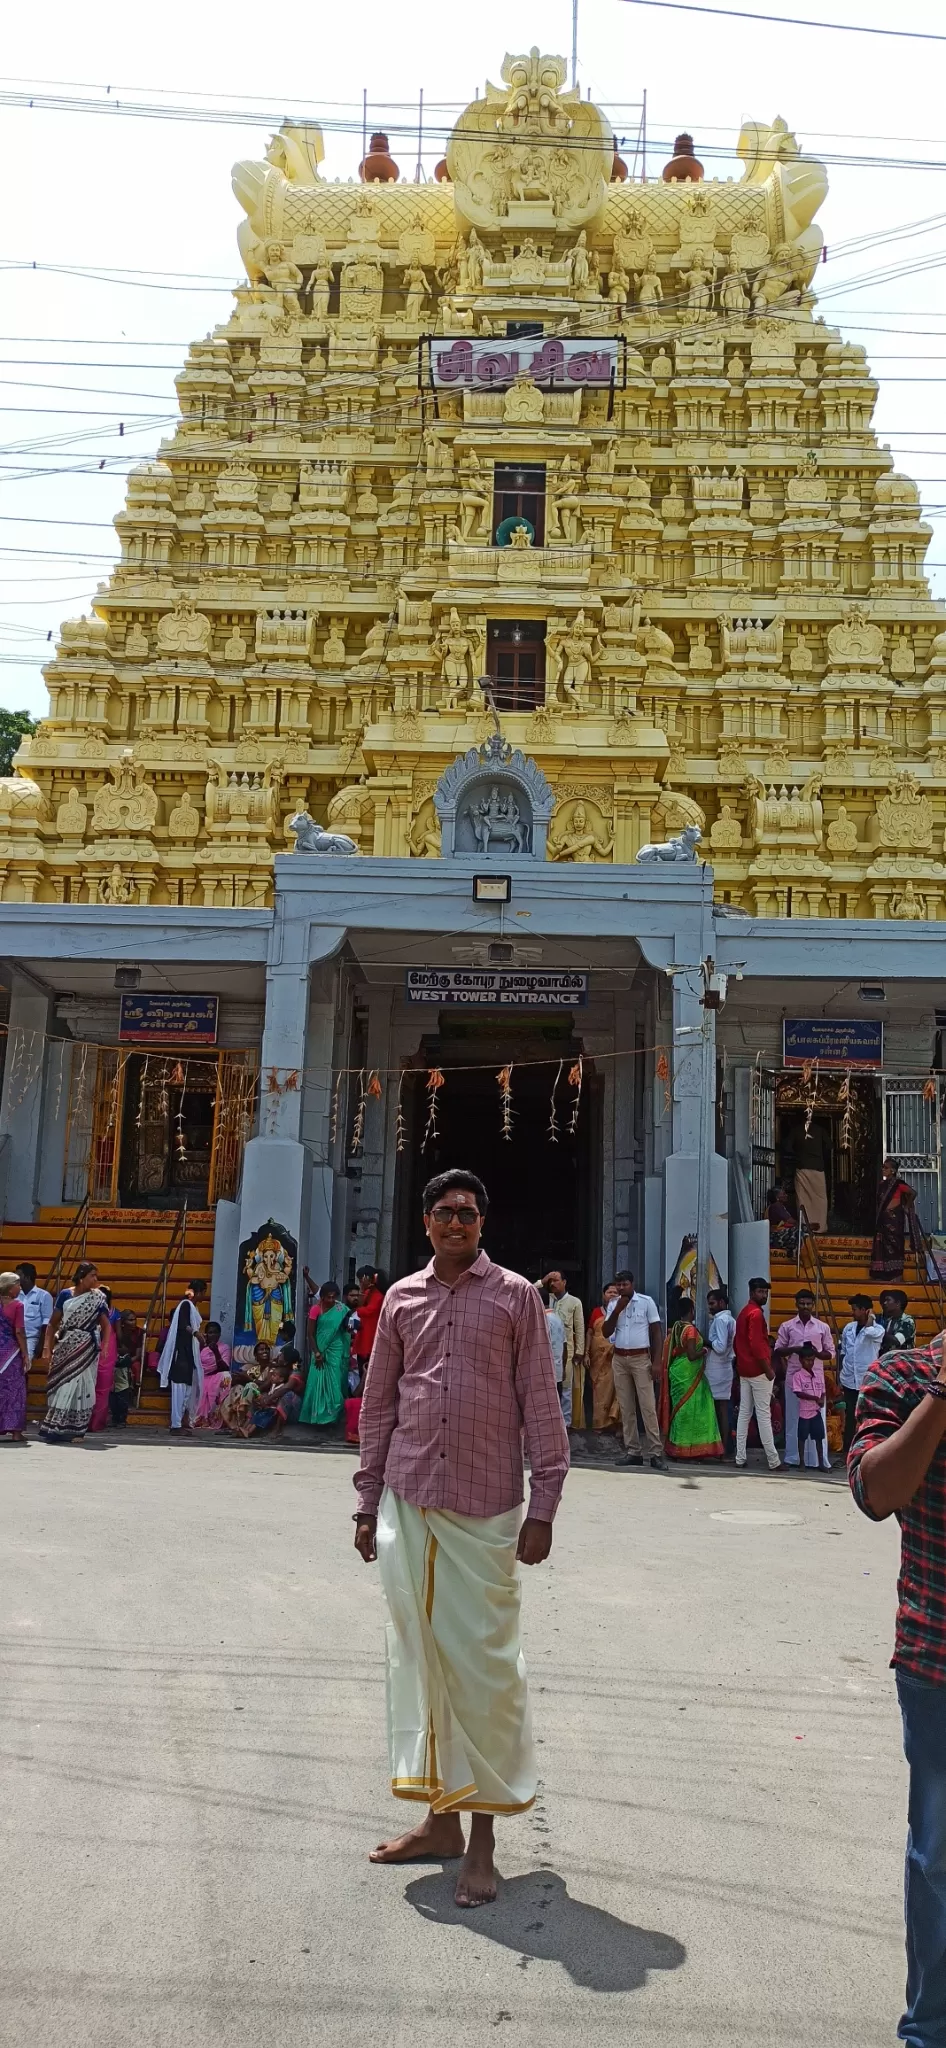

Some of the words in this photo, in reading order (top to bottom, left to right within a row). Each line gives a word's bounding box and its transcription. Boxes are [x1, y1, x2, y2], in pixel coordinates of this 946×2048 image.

[437, 340, 519, 382] சிவ
[529, 340, 611, 382] சிவ
[409, 973, 450, 988] மேற்கு
[454, 973, 496, 988] கோபுர
[499, 975, 583, 990] நுழைவாயில்
[410, 990, 448, 1001] WEST
[451, 991, 497, 1002] TOWER
[500, 992, 579, 1003] ENTRANCE
[146, 1009, 214, 1020] விநாயகர்
[140, 1019, 198, 1031] சன்னதி
